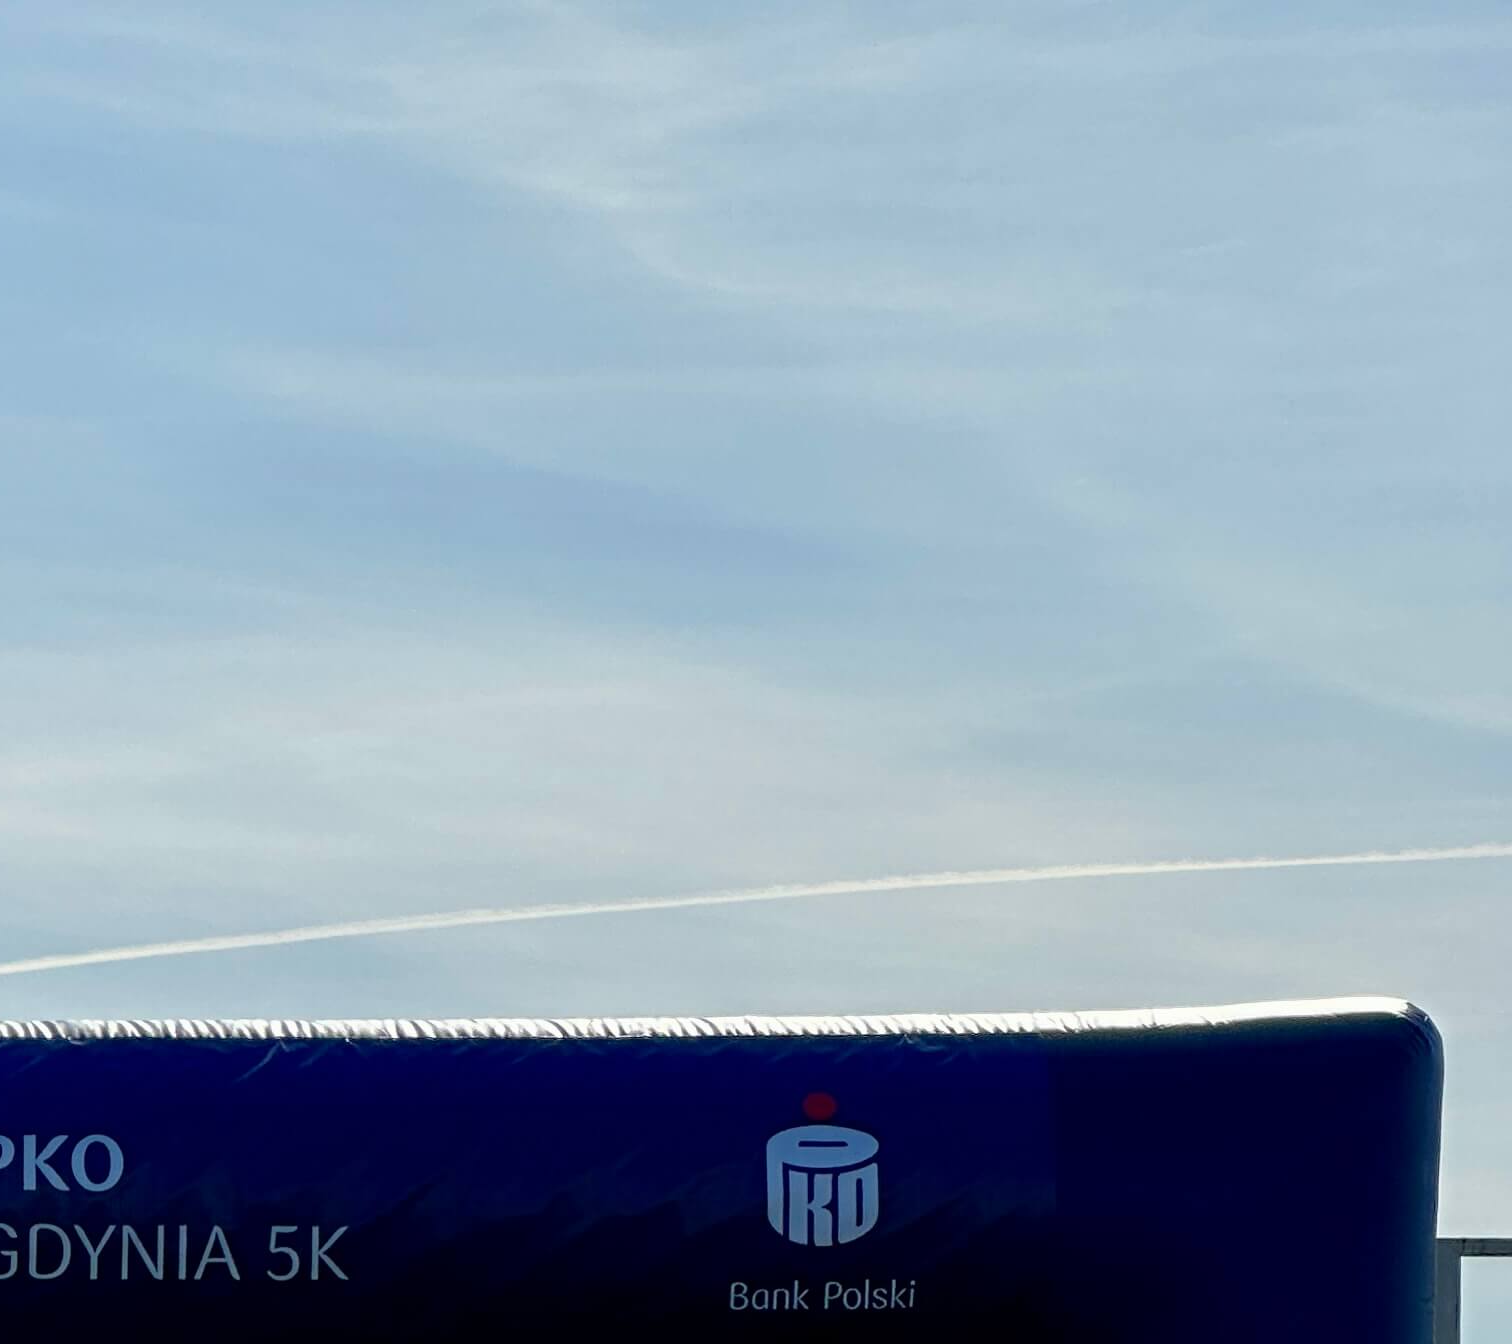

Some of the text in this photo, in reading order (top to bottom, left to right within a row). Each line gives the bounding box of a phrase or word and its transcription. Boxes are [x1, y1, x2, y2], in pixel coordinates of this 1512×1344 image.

[266, 1225, 349, 1281] 5K
[729, 1278, 916, 1311] Bank Polski
